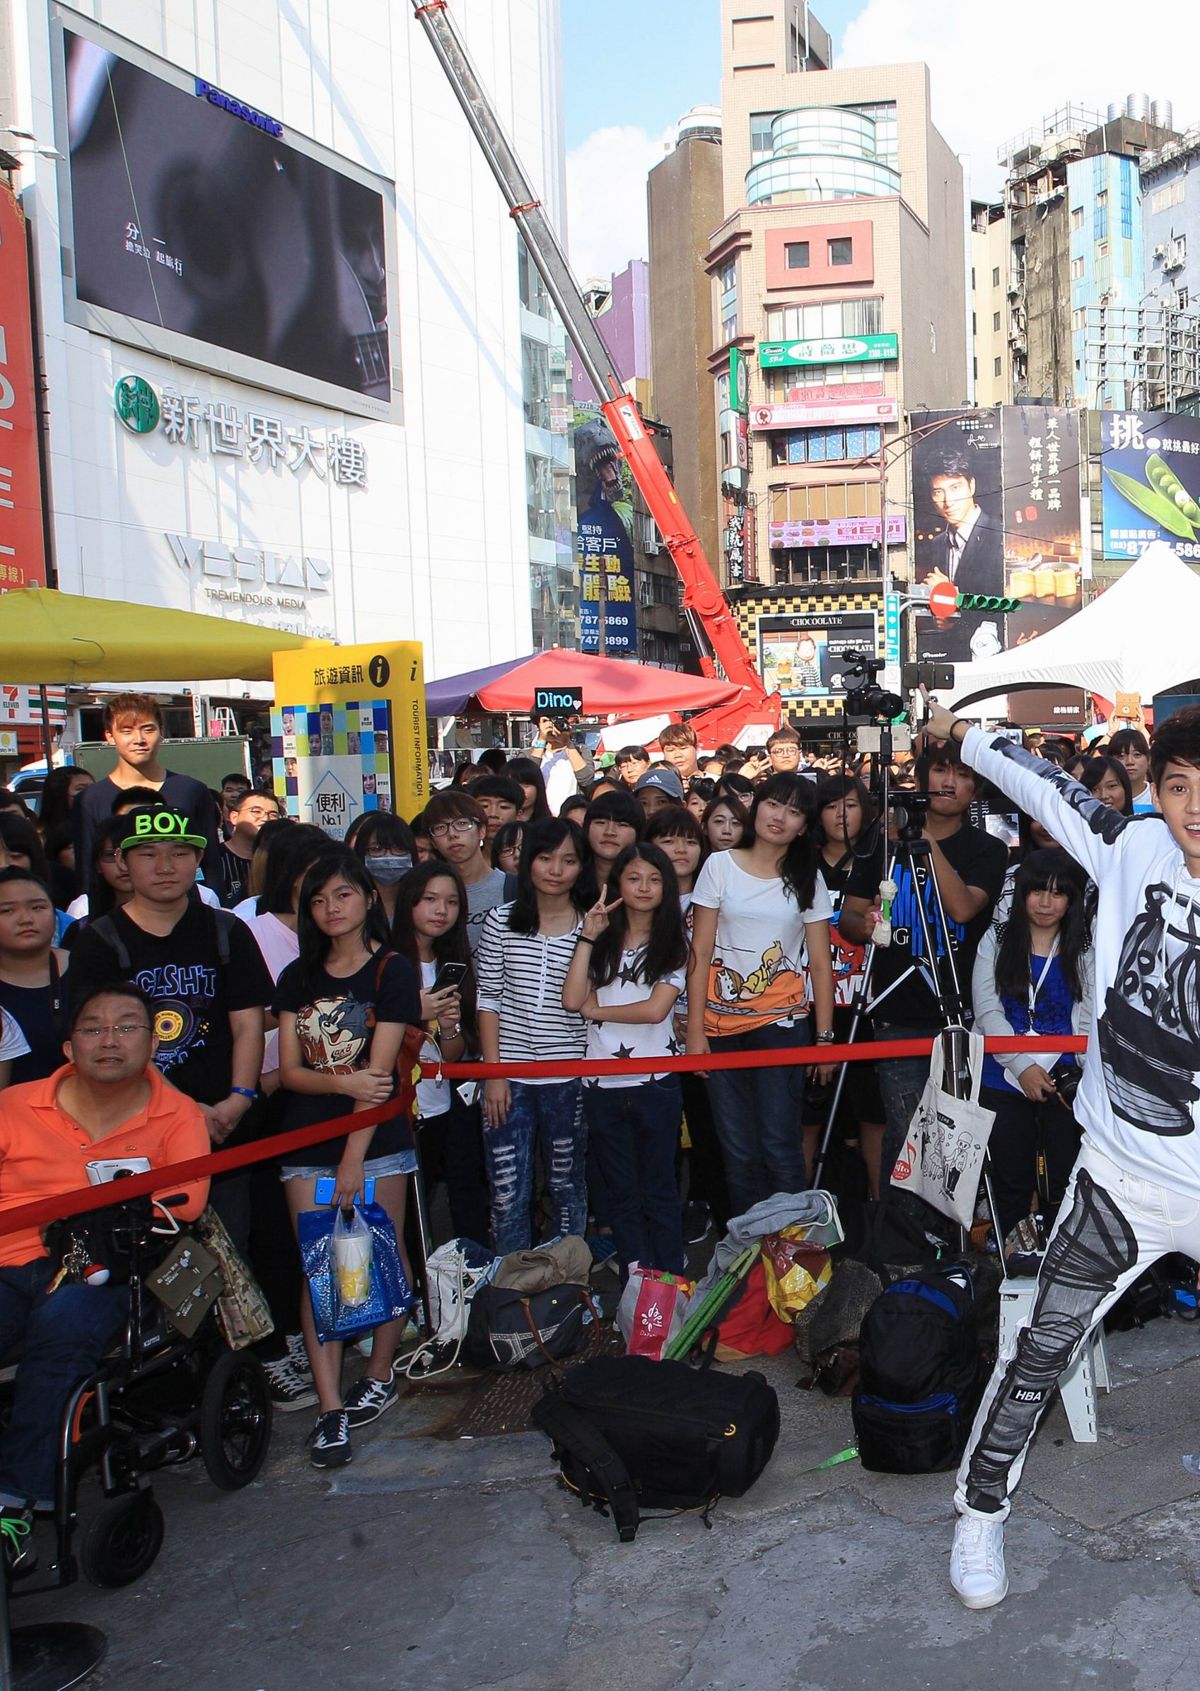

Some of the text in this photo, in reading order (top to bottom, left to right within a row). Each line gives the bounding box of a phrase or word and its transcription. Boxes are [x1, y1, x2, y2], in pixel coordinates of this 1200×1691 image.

[195, 79, 283, 138] Panasonic
[161, 387, 368, 489] 新世界大樓
[1110, 413, 1145, 450] 挑
[581, 525, 602, 535] 堅持
[204, 587, 307, 610] TREMENDOUS MEDIA
[313, 664, 364, 686] 旅遊資訊
[537, 690, 573, 709] Dino
[411, 700, 423, 797] TOURIST INFORMATION
[316, 793, 346, 813] 便利
[135, 812, 190, 835] BOY
[322, 814, 342, 826] No.1
[970, 801, 980, 829] LUCY
[1015, 1388, 1042, 1402] HBA
